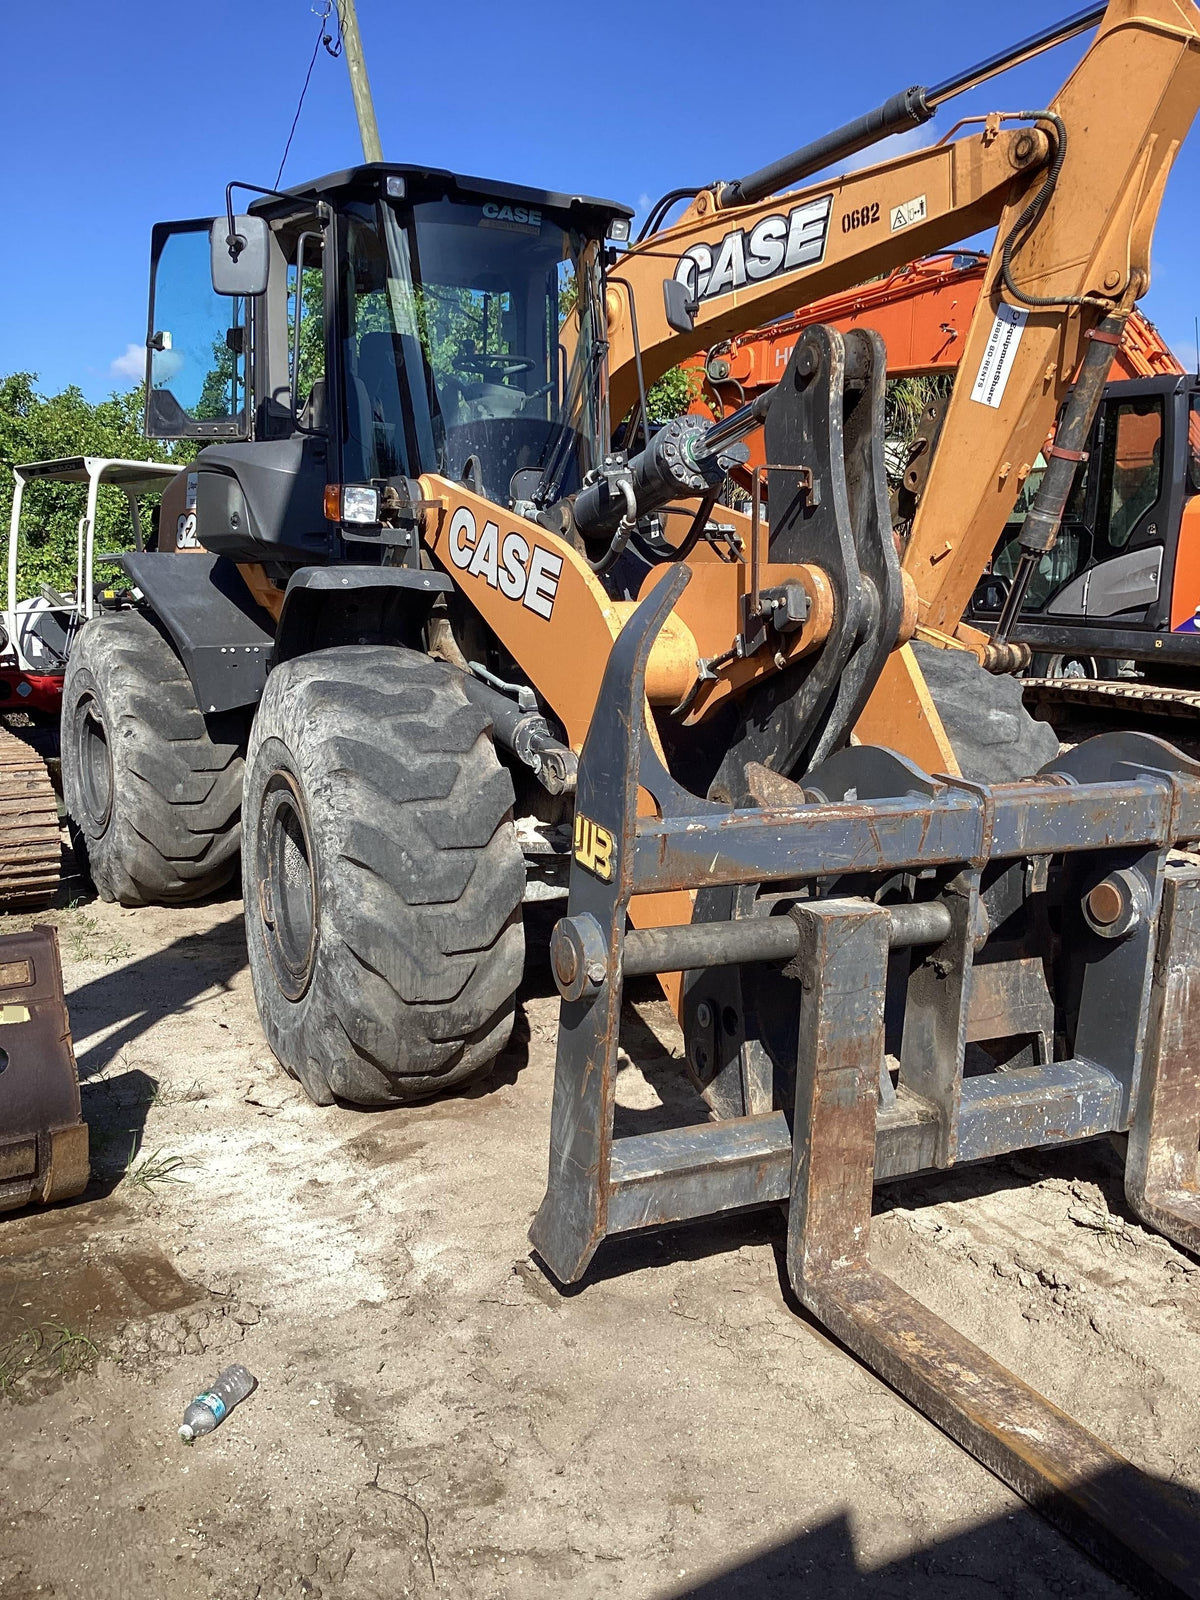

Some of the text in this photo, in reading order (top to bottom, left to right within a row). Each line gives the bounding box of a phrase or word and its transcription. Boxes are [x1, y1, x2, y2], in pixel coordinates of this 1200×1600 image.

[482, 202, 542, 226] CASE
[673, 194, 834, 303] CASE
[841, 202, 880, 234] 0682
[448, 505, 564, 622] CASE
